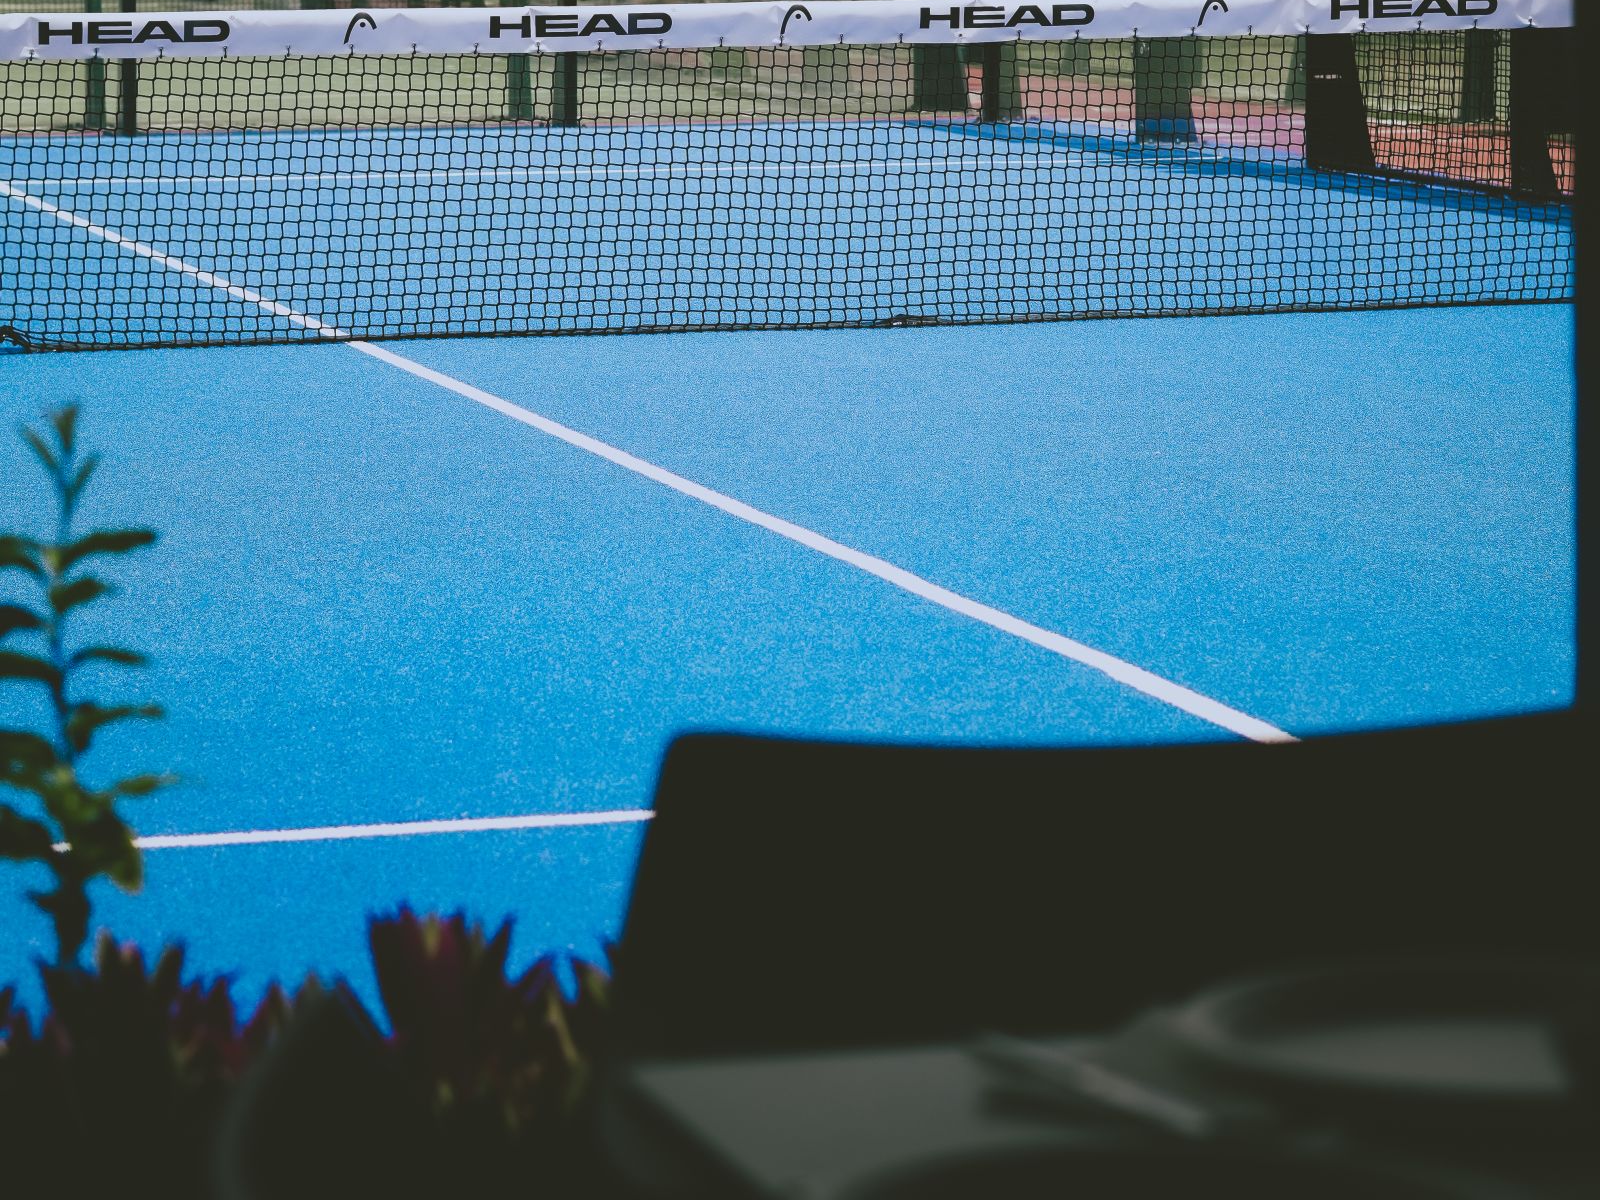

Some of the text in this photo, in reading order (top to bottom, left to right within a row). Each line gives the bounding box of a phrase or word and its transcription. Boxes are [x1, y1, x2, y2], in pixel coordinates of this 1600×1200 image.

[489, 12, 673, 39] HEAD
[919, 3, 1095, 30] HEAD
[38, 19, 231, 45] HEAD
